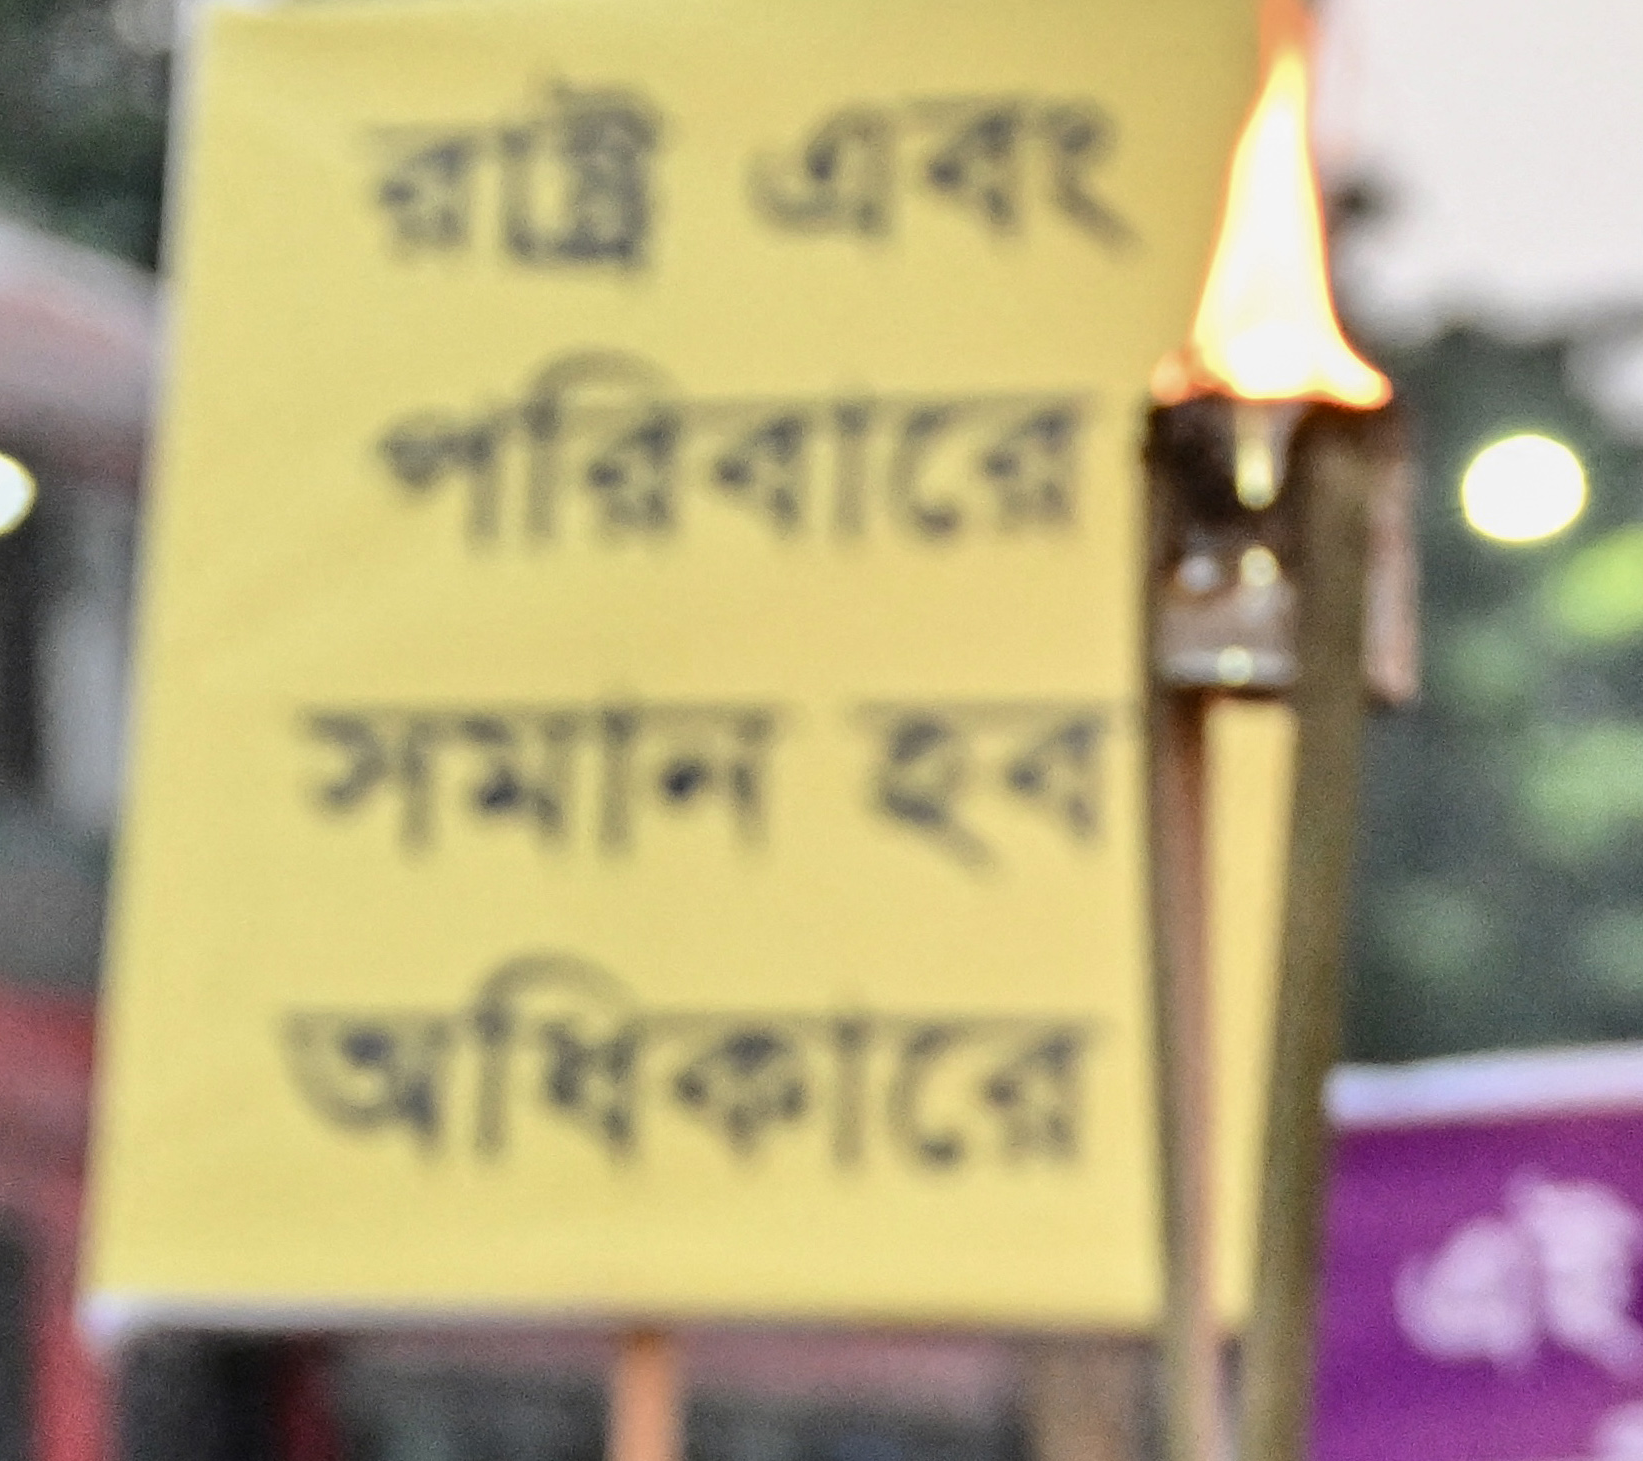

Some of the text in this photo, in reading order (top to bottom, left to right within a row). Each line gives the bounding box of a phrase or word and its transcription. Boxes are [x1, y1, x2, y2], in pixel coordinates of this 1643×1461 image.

[361, 70, 1139, 277] রাষ্ট্র এবং
[375, 347, 1099, 552] পরিবারে
[293, 691, 1125, 880] সমান হব
[276, 947, 1109, 1174] অধিকারে
